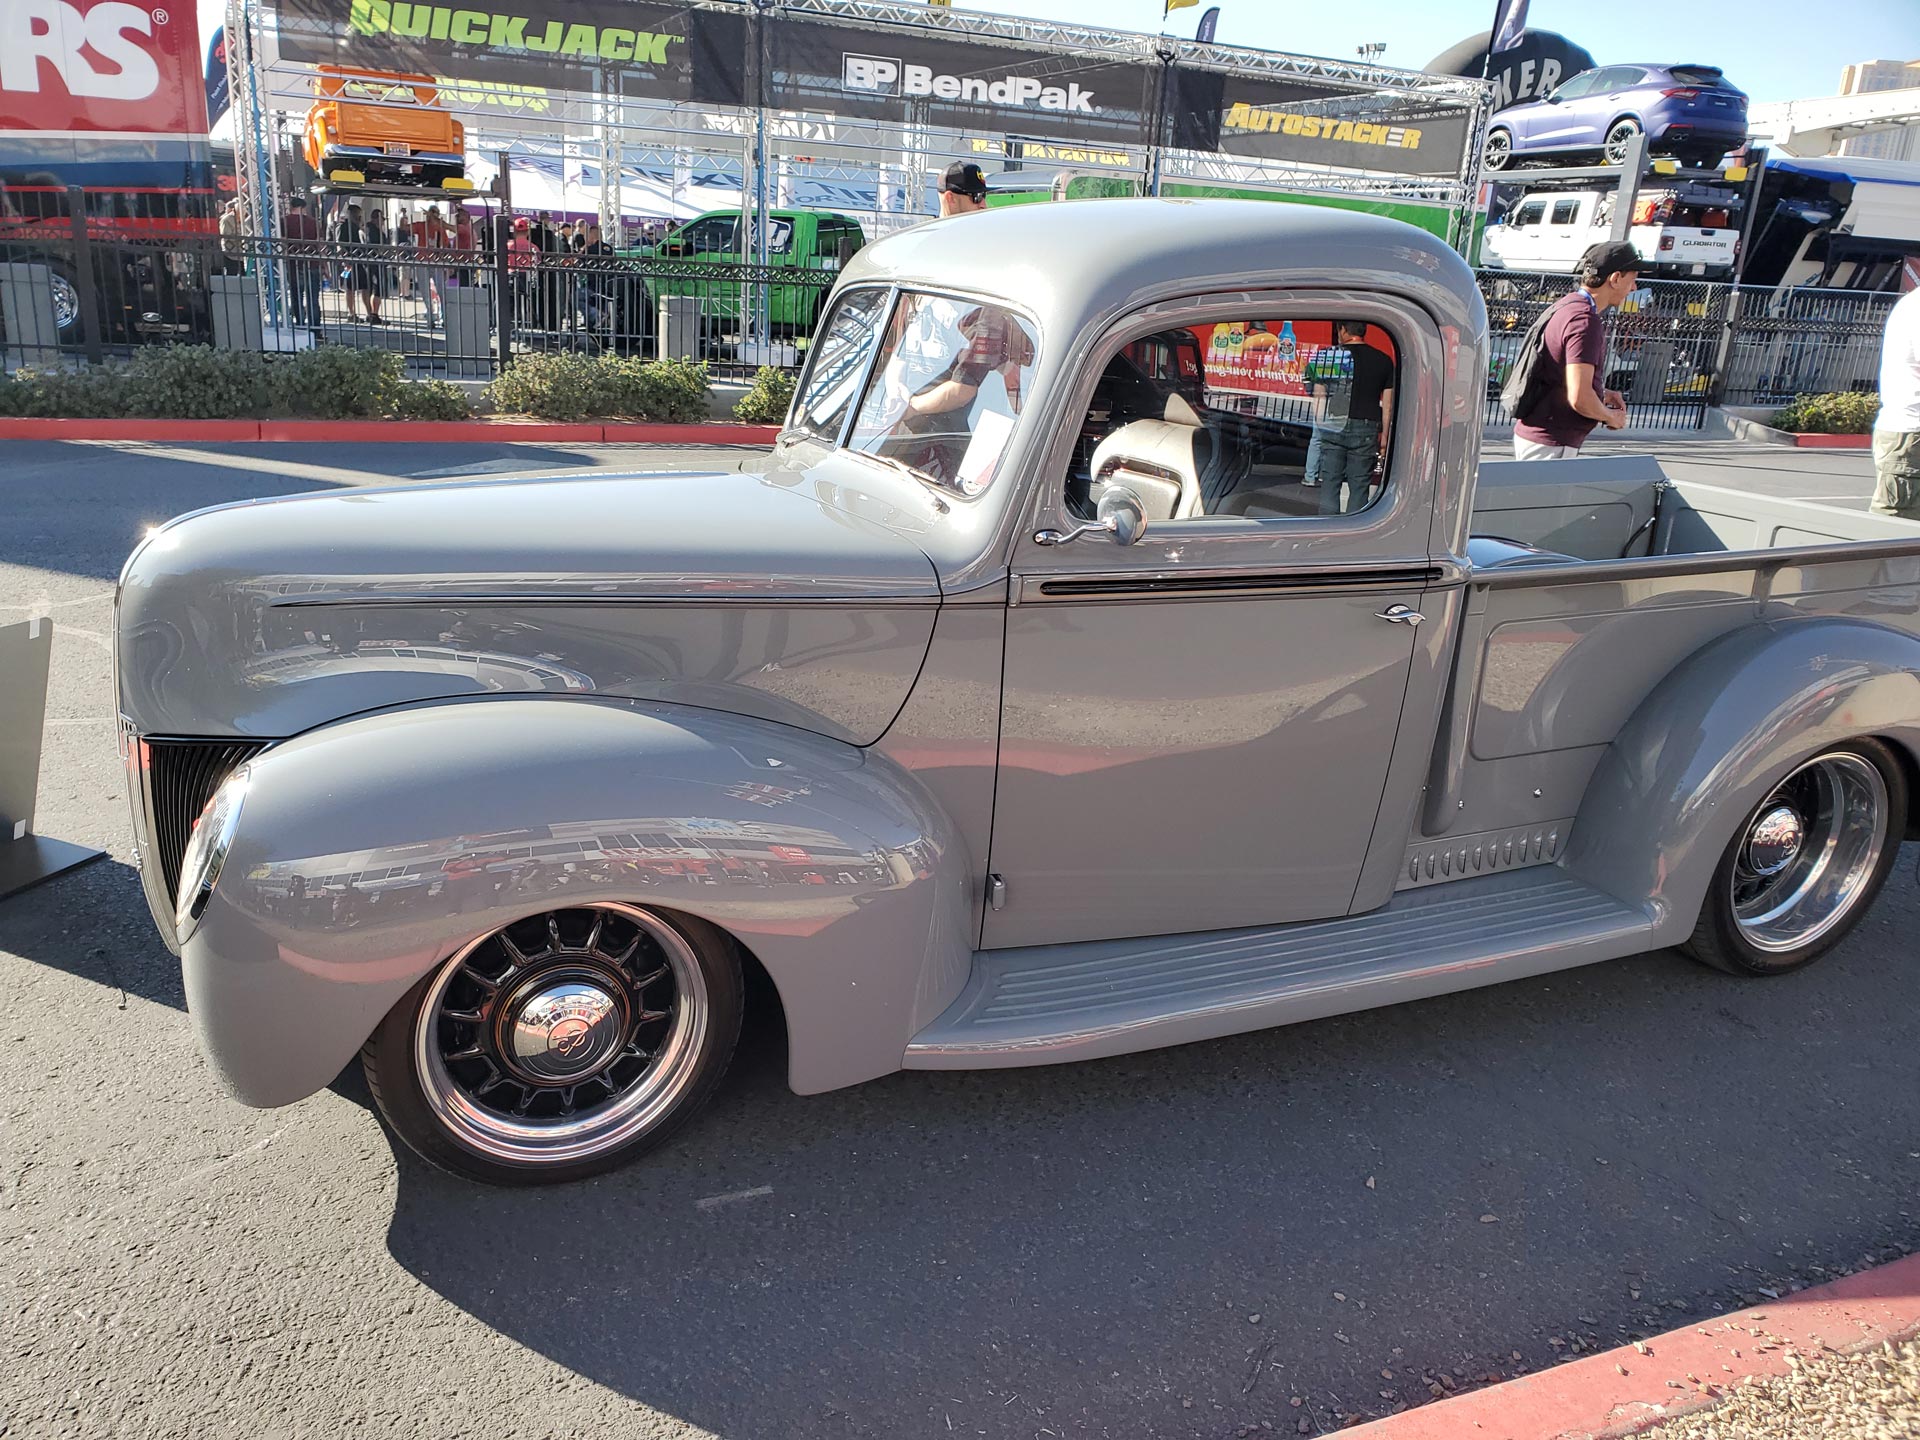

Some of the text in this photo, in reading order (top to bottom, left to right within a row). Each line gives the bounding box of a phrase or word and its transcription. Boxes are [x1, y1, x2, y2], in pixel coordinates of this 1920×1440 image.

[846, 57, 898, 90] BP
[1224, 102, 1422, 149] AUTOSTACKER
[1682, 239, 1727, 248] GLADIATOR
